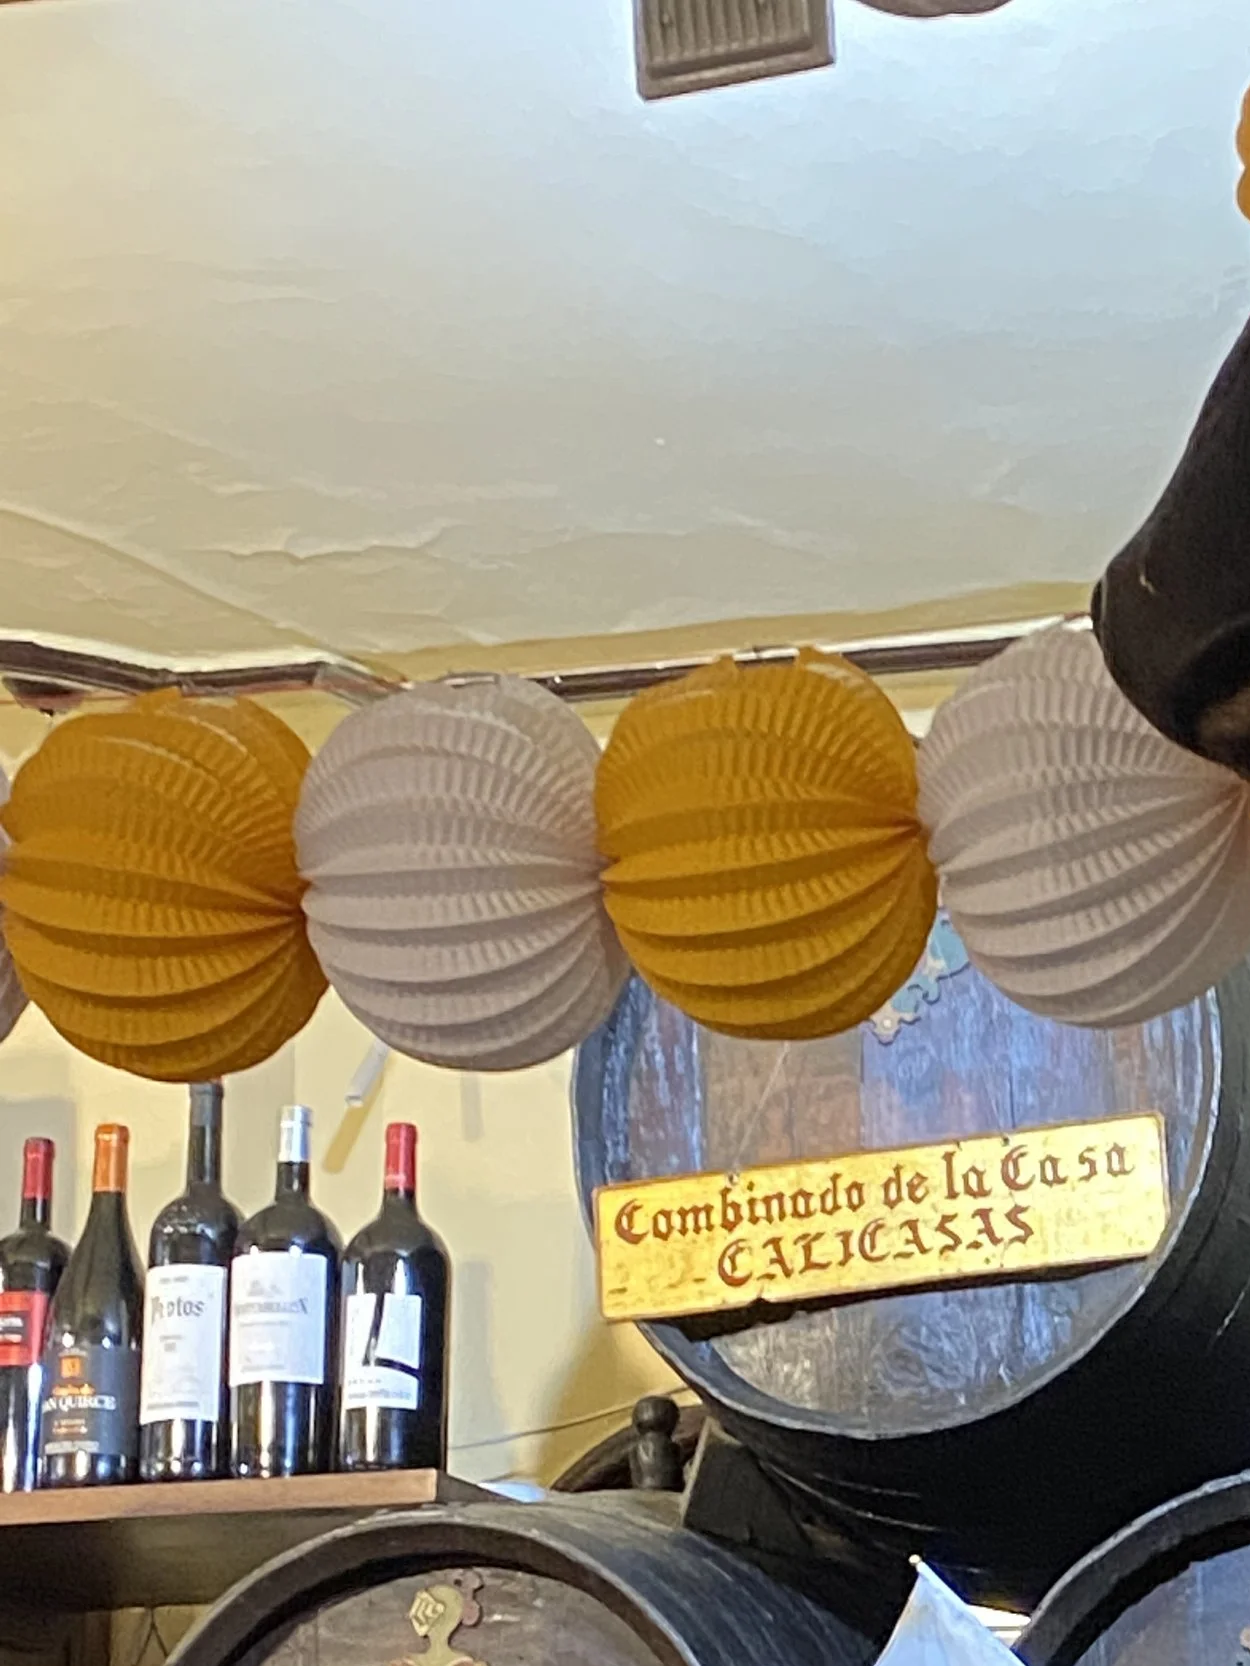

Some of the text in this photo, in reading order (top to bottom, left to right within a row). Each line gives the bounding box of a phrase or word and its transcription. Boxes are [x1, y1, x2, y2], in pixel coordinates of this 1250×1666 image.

[614, 1142, 1135, 1245] Combinado de la Casa
[717, 1203, 1034, 1287] CALICASAS
